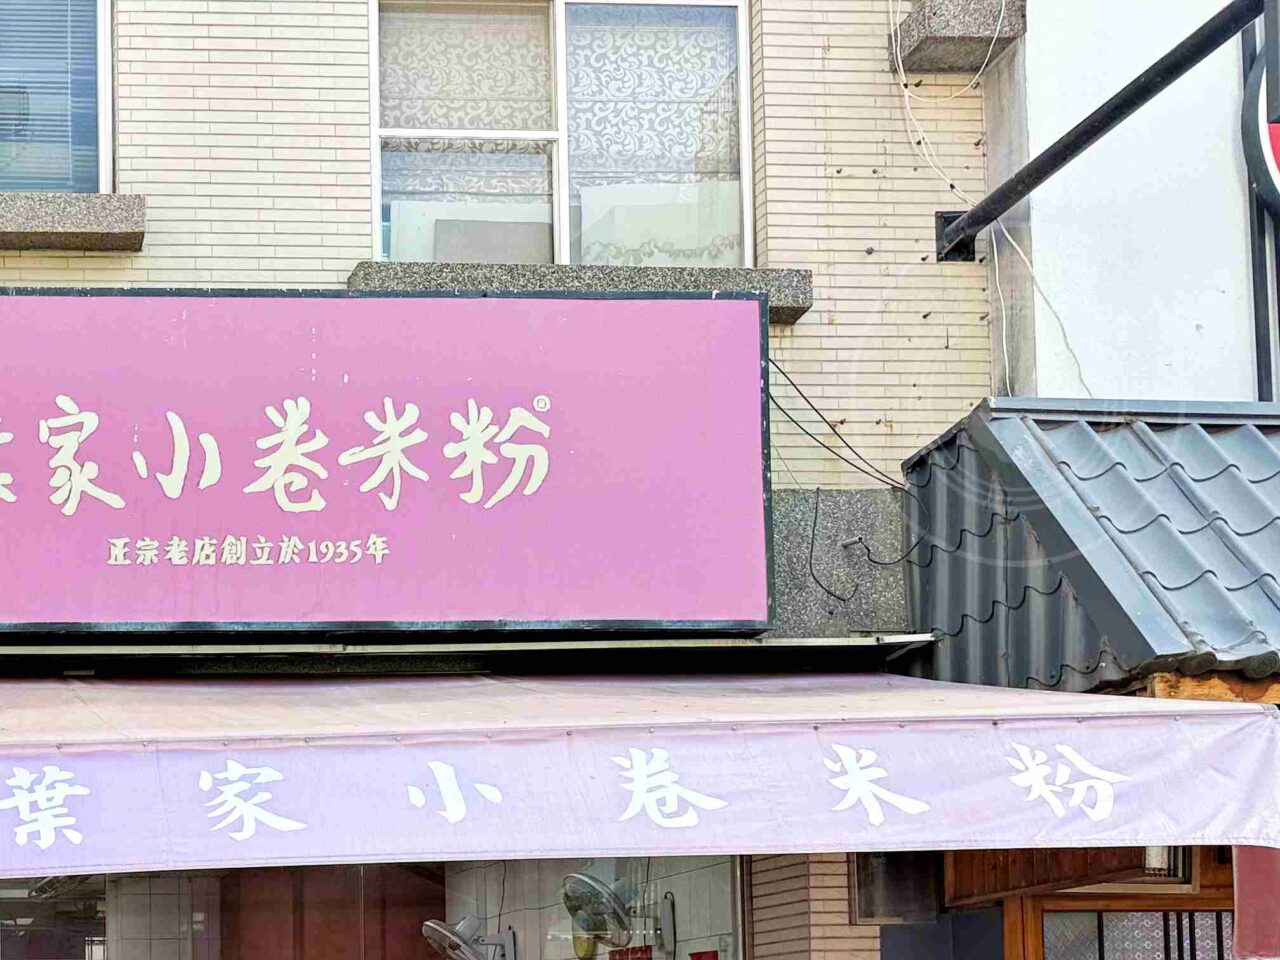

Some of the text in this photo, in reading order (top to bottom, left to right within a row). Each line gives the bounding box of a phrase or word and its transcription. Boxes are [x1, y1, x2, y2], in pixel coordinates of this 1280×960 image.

[106, 534, 390, 566] 正宗老店創立於1935年
